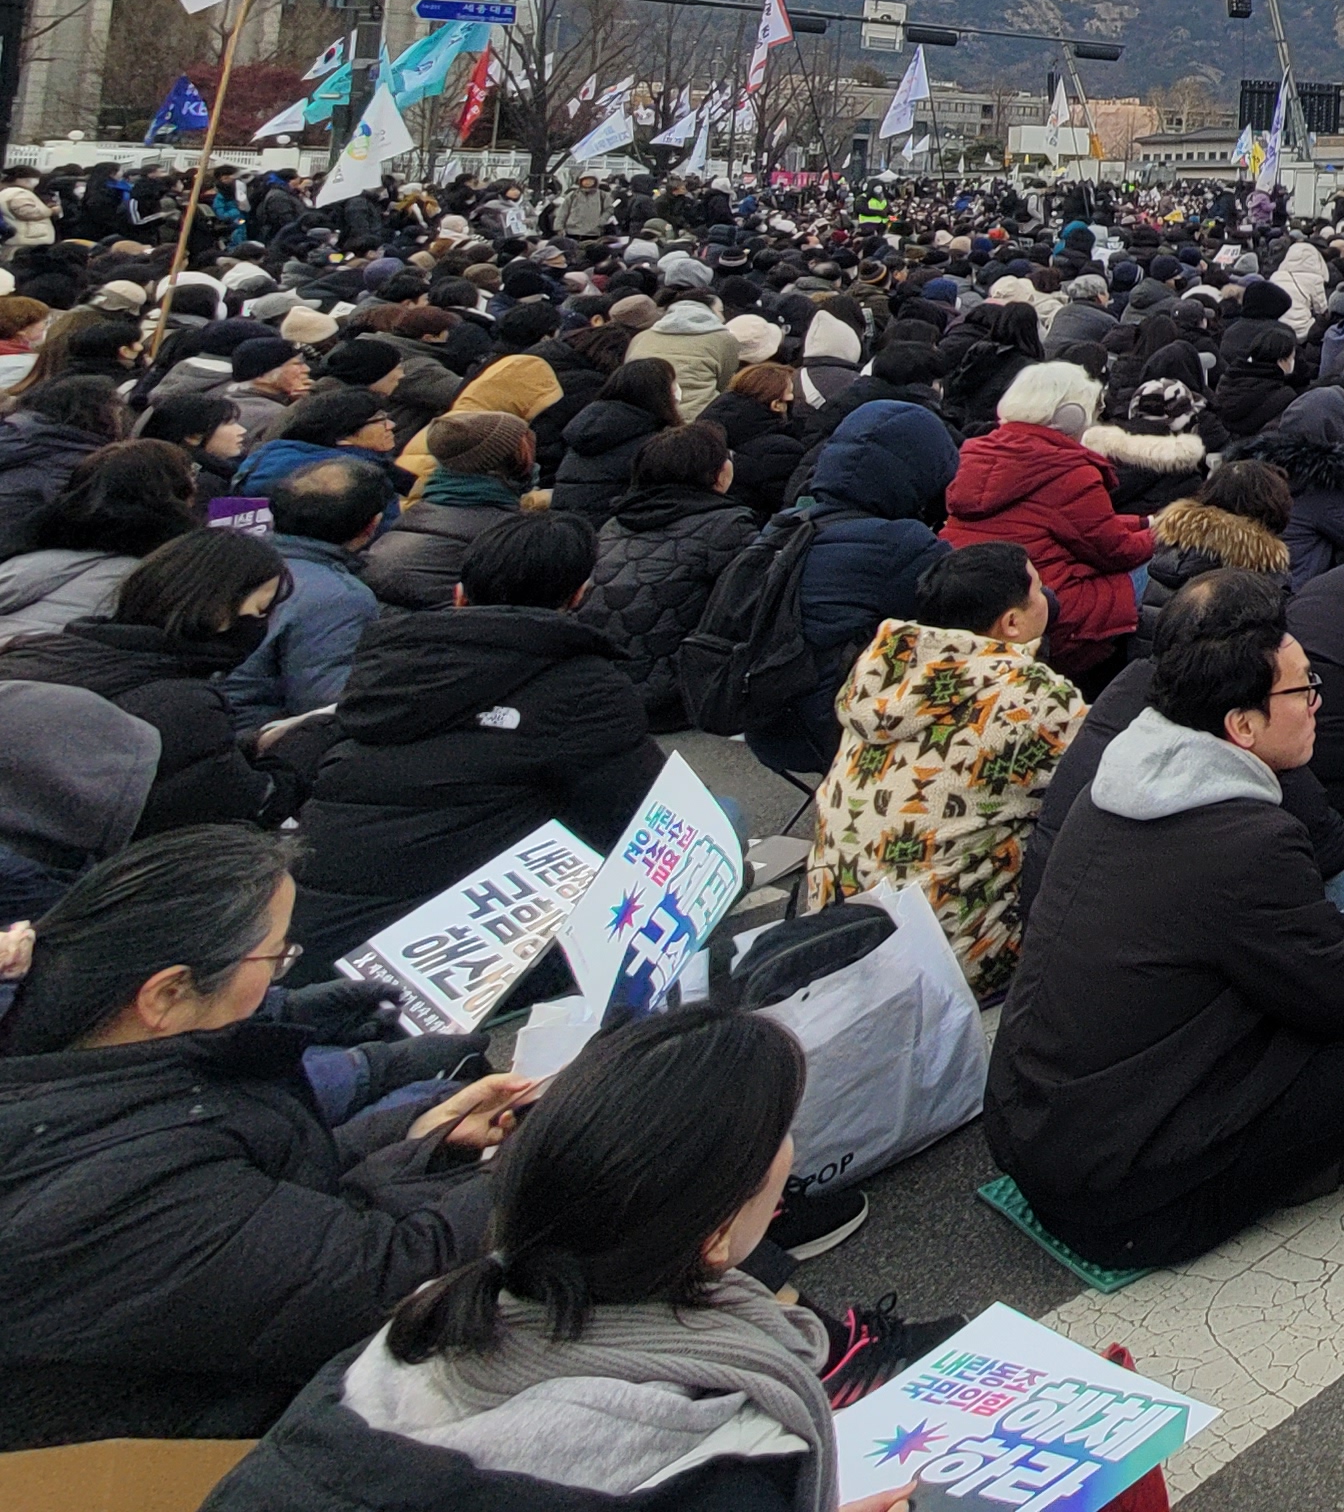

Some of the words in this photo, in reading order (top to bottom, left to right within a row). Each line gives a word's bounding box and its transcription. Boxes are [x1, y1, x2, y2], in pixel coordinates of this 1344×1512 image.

[644, 800, 700, 853] 내란수괴
[621, 827, 682, 888] 윤석열
[900, 1373, 1018, 1418] 국민의힘
[930, 1348, 1049, 1394] 내란동조
[1003, 1376, 1185, 1463] 해체
